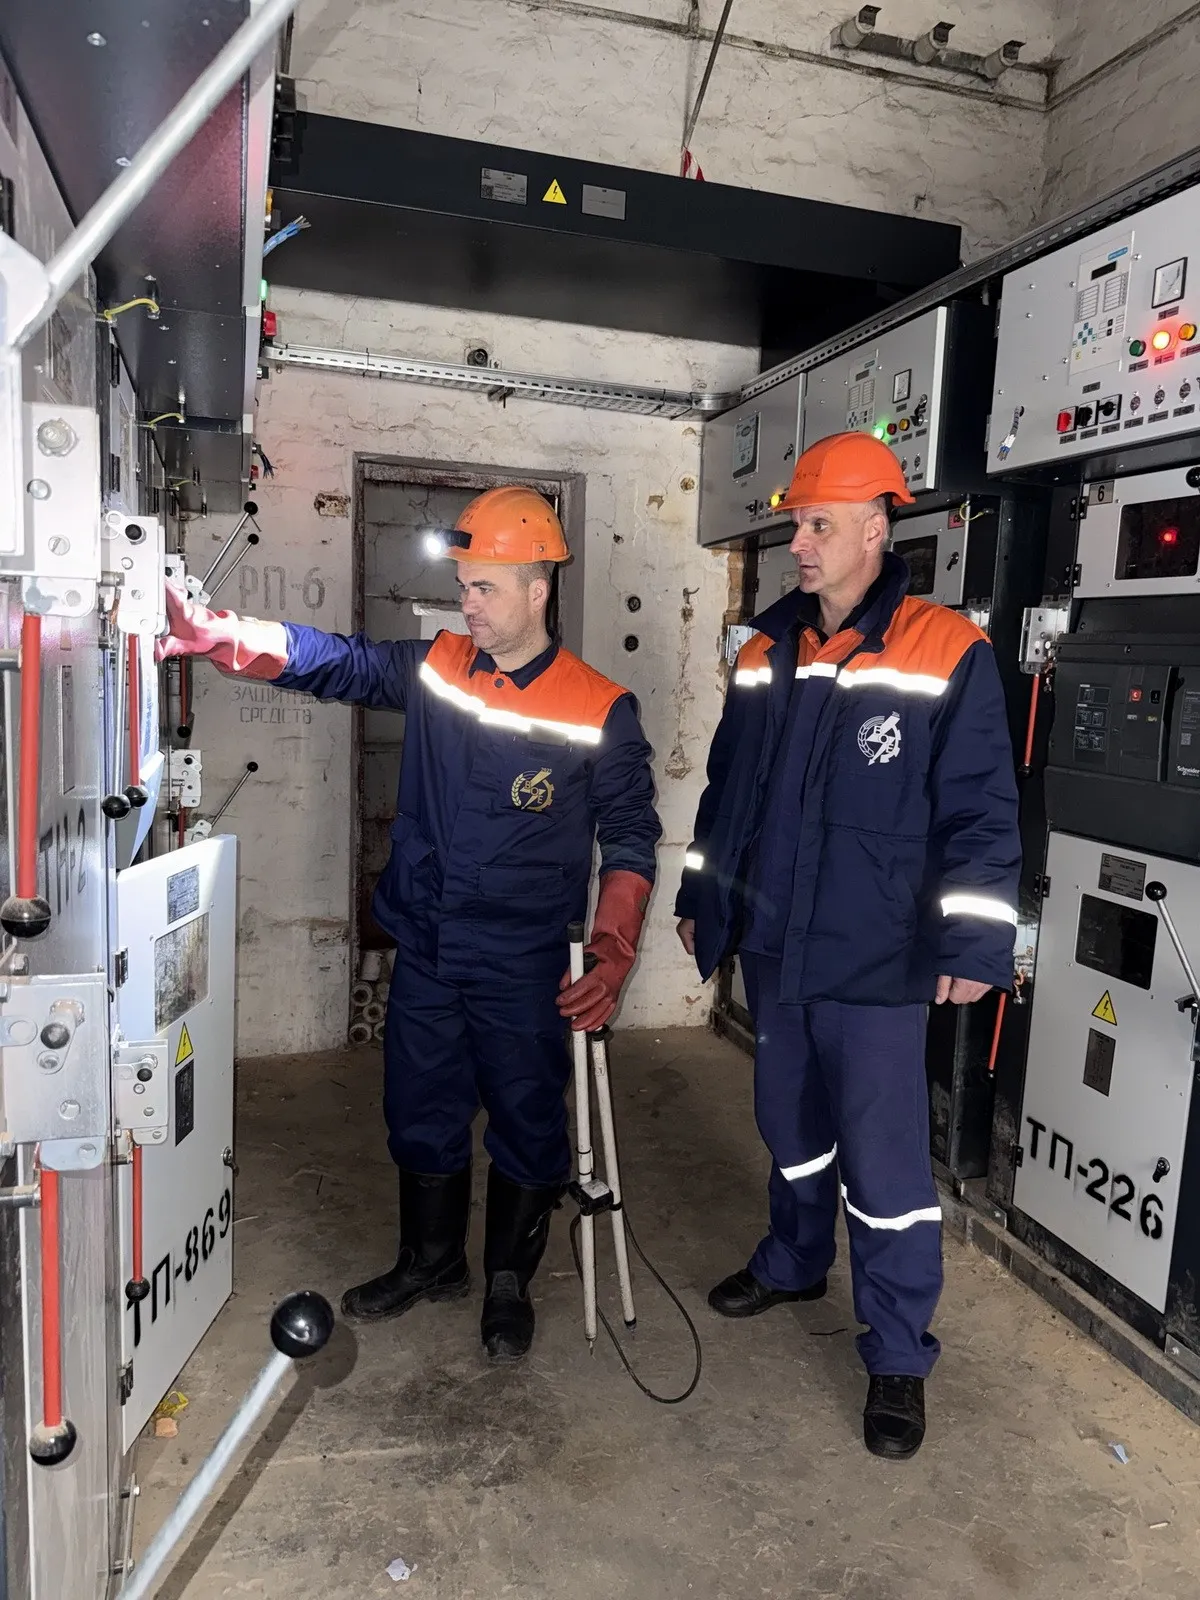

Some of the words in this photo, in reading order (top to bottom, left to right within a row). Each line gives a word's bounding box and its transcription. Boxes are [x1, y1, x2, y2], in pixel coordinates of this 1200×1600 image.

[1097, 485, 1105, 502] 6
[239, 564, 326, 611] РП-6
[240, 706, 312, 725] СРЕДСТВ
[1026, 1115, 1165, 1240] ТП-226
